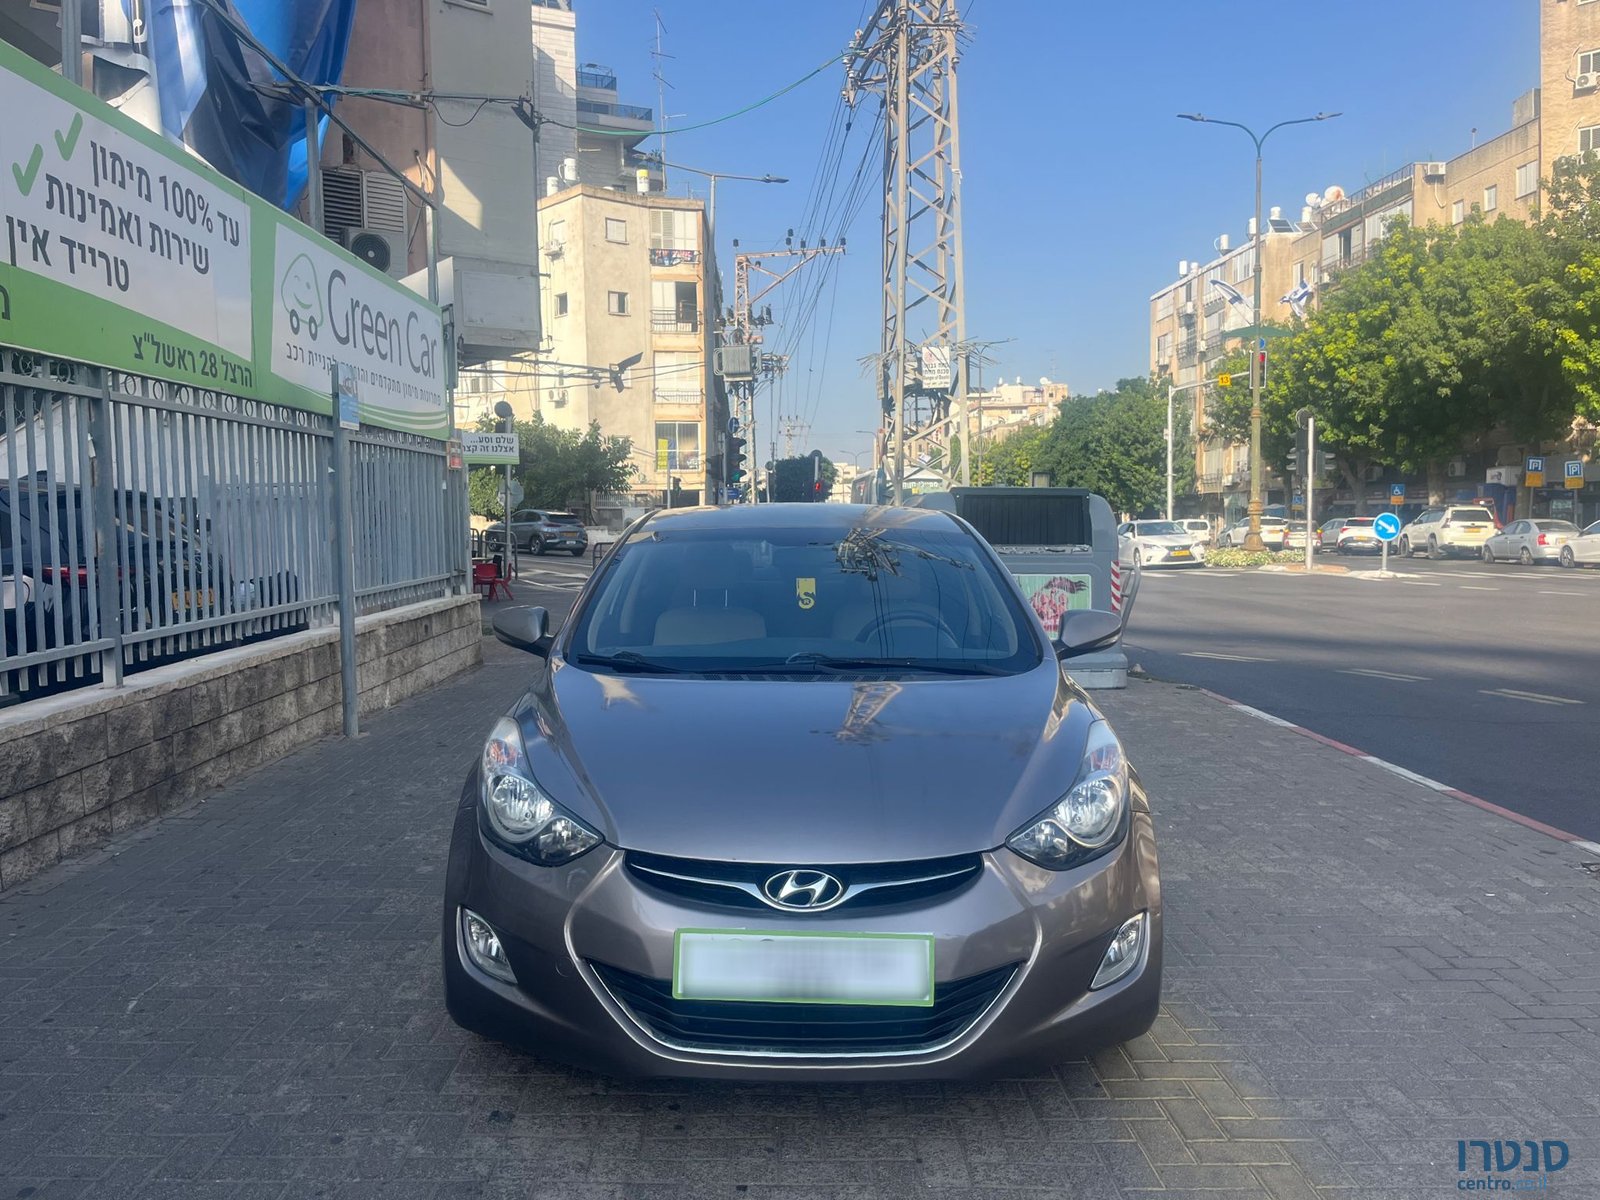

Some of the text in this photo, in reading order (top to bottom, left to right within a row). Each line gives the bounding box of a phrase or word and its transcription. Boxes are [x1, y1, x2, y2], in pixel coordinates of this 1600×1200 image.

[90, 140, 240, 247] עד 100% מימון
[45, 173, 210, 275] שירות ואמינות
[6, 215, 130, 292] טרייד אין
[327, 269, 437, 379] Green Car
[199, 350, 218, 378] 28
[286, 342, 304, 363] רכב
[221, 354, 253, 388] הרצל
[371, 372, 401, 394] מתקדמים
[403, 383, 419, 399] מימון
[480, 445, 489, 453] זה
[492, 445, 514, 453] אצלנו
[496, 436, 514, 444] שלם
